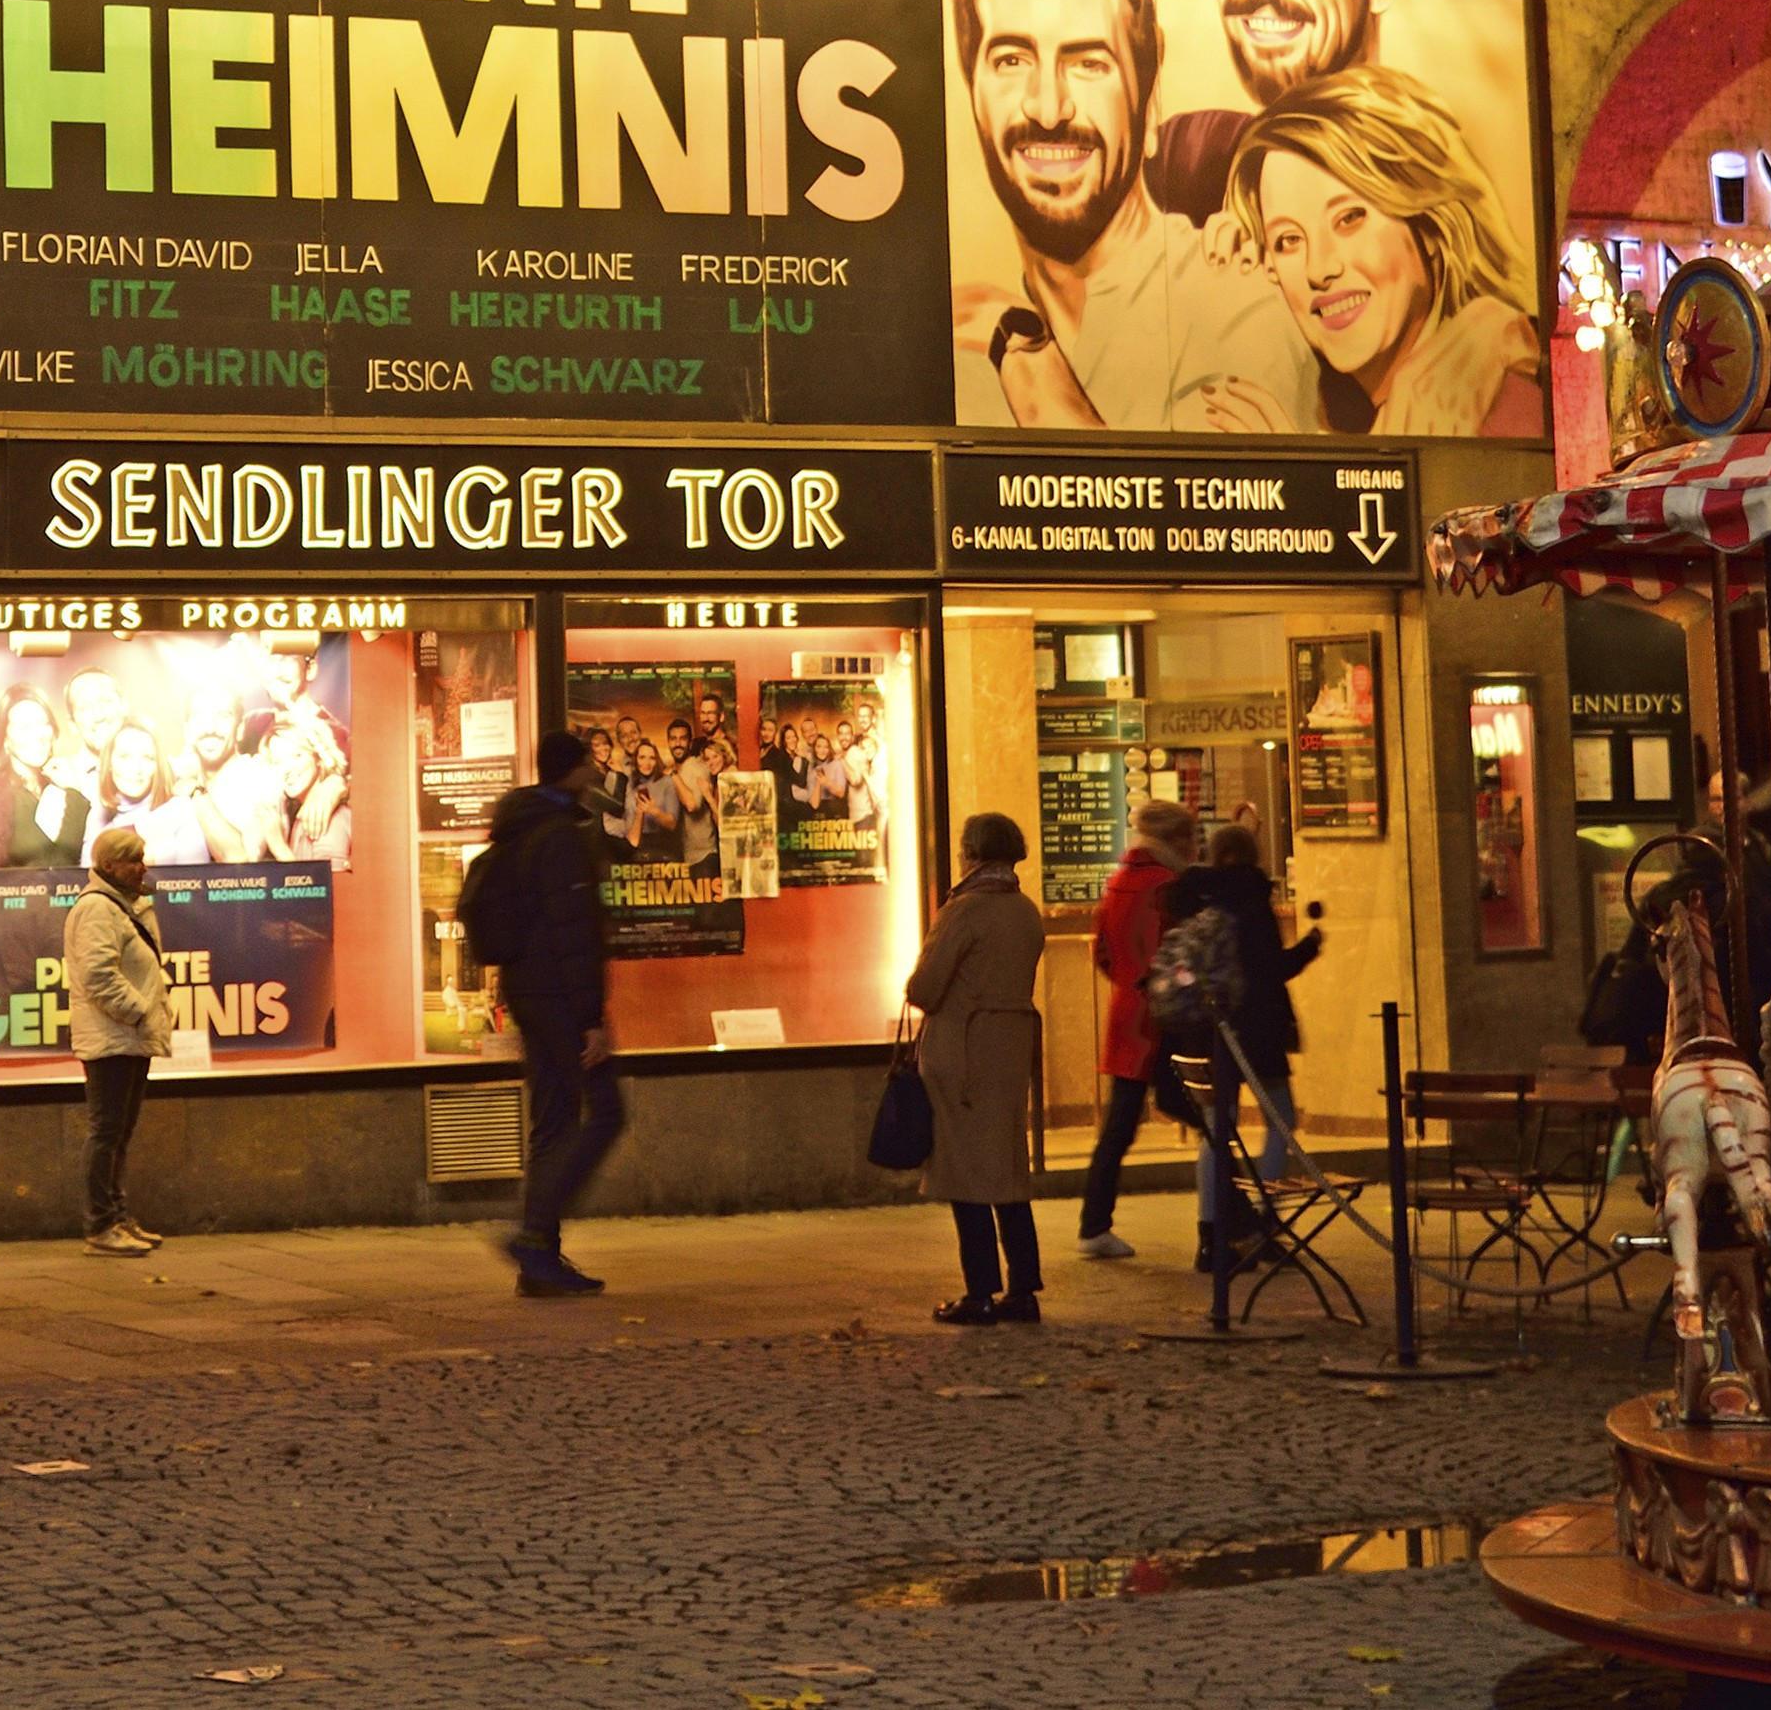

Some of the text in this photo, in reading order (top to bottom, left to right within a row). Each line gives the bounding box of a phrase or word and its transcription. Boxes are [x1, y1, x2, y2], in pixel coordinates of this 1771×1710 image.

[1, 230, 145, 267] FLORIAN
[155, 237, 253, 271] DAVID
[294, 243, 384, 276] JELLA
[476, 248, 634, 282] KAROLINE
[681, 254, 849, 287] FREDERICK
[88, 278, 179, 320] FITZ
[269, 283, 412, 328] HAASE
[450, 291, 662, 332] HERFURTH
[728, 296, 815, 336] LAU
[101, 343, 329, 390] MÖHRING
[365, 358, 474, 393] JESSICA
[489, 354, 706, 397] SCHWARZ
[998, 474, 1286, 512] MODERNSTE TECHNIK
[1335, 468, 1405, 491] EINGANG
[46, 457, 630, 550] SENDLINGER
[667, 466, 848, 550] TOR
[951, 525, 1335, 554] 6-KANAL DIGITAL TON DOLBY SURROUND
[182, 599, 408, 630] PROGRAMM
[666, 601, 801, 629] HEUTE
[1571, 692, 1684, 716] ENNEDY'S
[776, 830, 879, 851] GEHEIMNIS
[797, 819, 856, 833] PERFEKTE
[609, 861, 692, 880] PERFEKTE
[598, 876, 726, 907] EHEIMNIS
